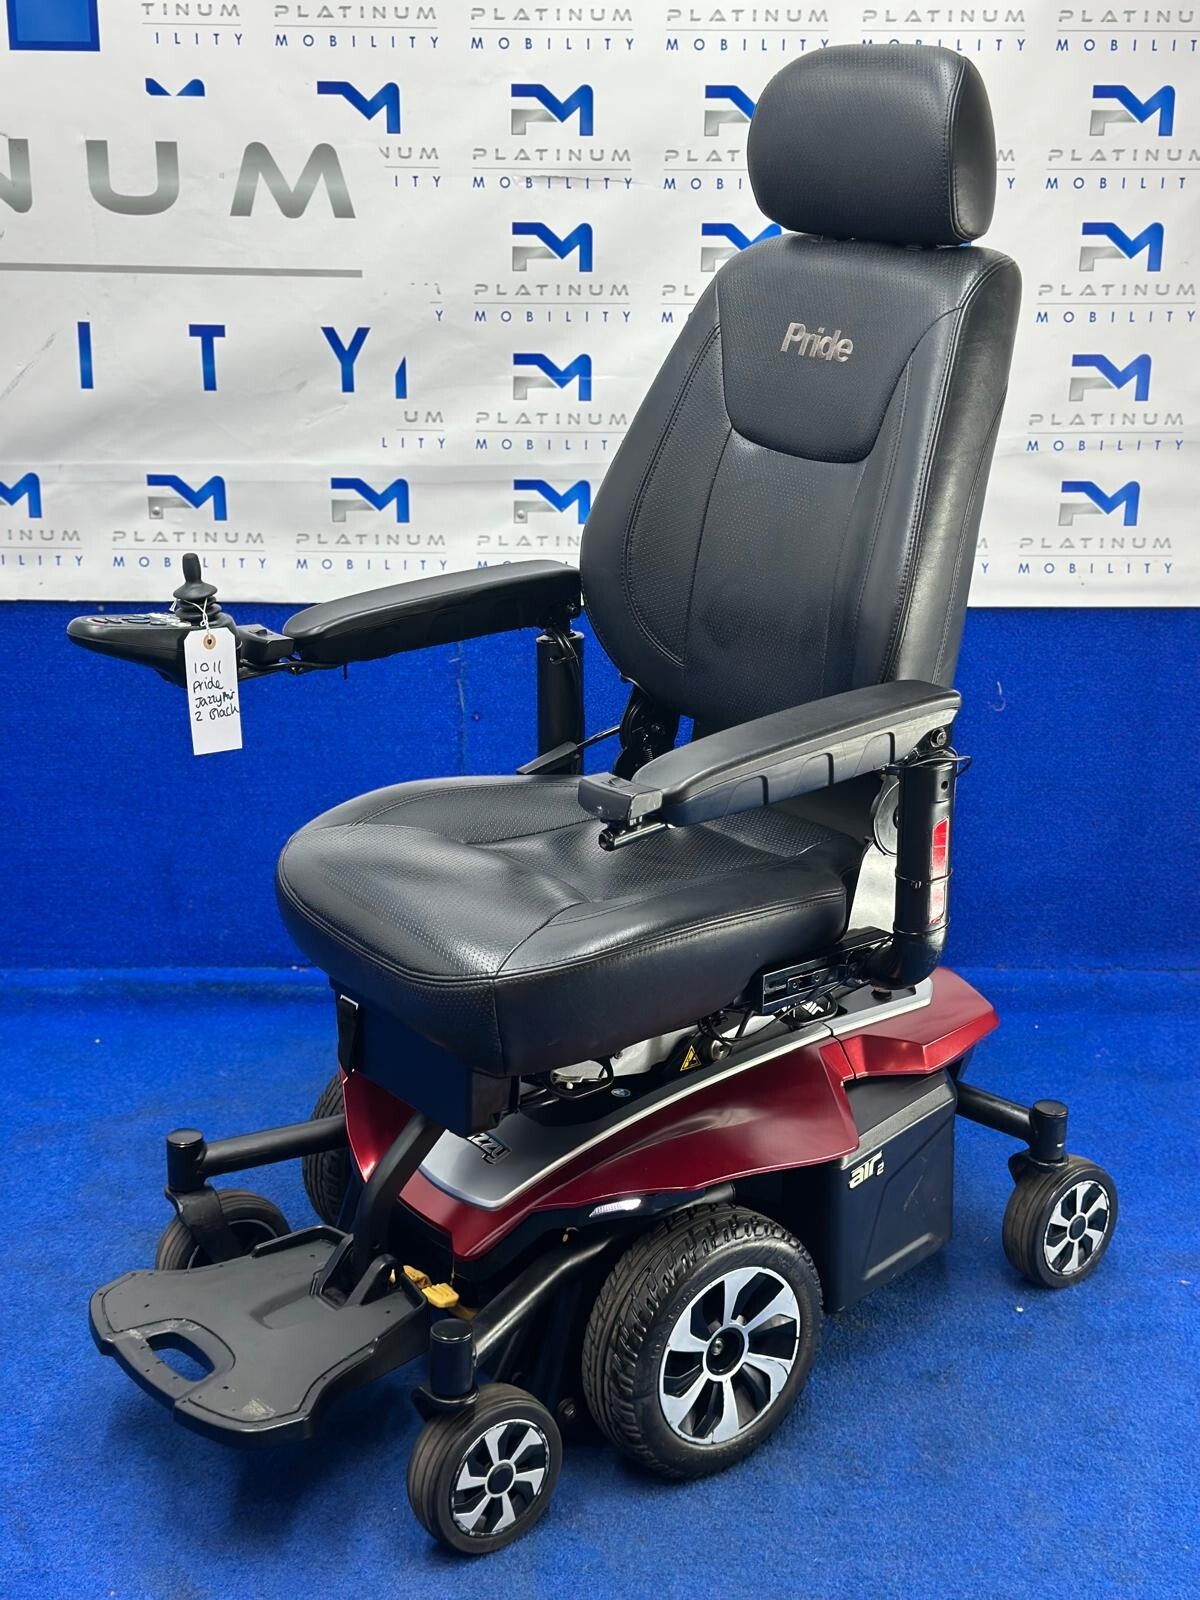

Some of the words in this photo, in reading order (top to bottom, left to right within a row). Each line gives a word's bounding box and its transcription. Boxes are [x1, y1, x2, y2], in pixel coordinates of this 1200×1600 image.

[275, 5, 437, 19] PLATINUM
[471, 8, 633, 21] PLATINUM
[666, 9, 828, 22] PLATINUM
[863, 10, 1025, 22] PLATINUM
[275, 34, 439, 48] MOBILITY
[471, 37, 634, 50] MOBILITY
[666, 38, 829, 51] MOBILITY
[472, 148, 632, 162] PLATINUM
[664, 149, 741, 162] PLAT
[472, 176, 633, 190] MOBILITY
[663, 178, 742, 190] MOBI
[474, 284, 630, 296] PLATINUM
[1037, 283, 1196, 296] PLATINUM
[474, 310, 631, 323] MOBILITY
[1035, 310, 1196, 323] MOBILITY
[780, 322, 853, 362] Pride
[476, 412, 628, 425] PLATINUM
[1028, 413, 1184, 426] PLATINUM
[475, 438, 608, 450] MOBILIT
[1026, 440, 1184, 451] MOBILITY
[112, 531, 265, 544] PLATINUM
[296, 533, 446, 545] PLATINUM
[477, 535, 580, 546] PLATIN
[1019, 537, 1172, 549] PLATINUM
[113, 557, 267, 569] MOBLITY
[296, 558, 448, 571] MOBILITY
[1018, 563, 1173, 574] MOBILITY
